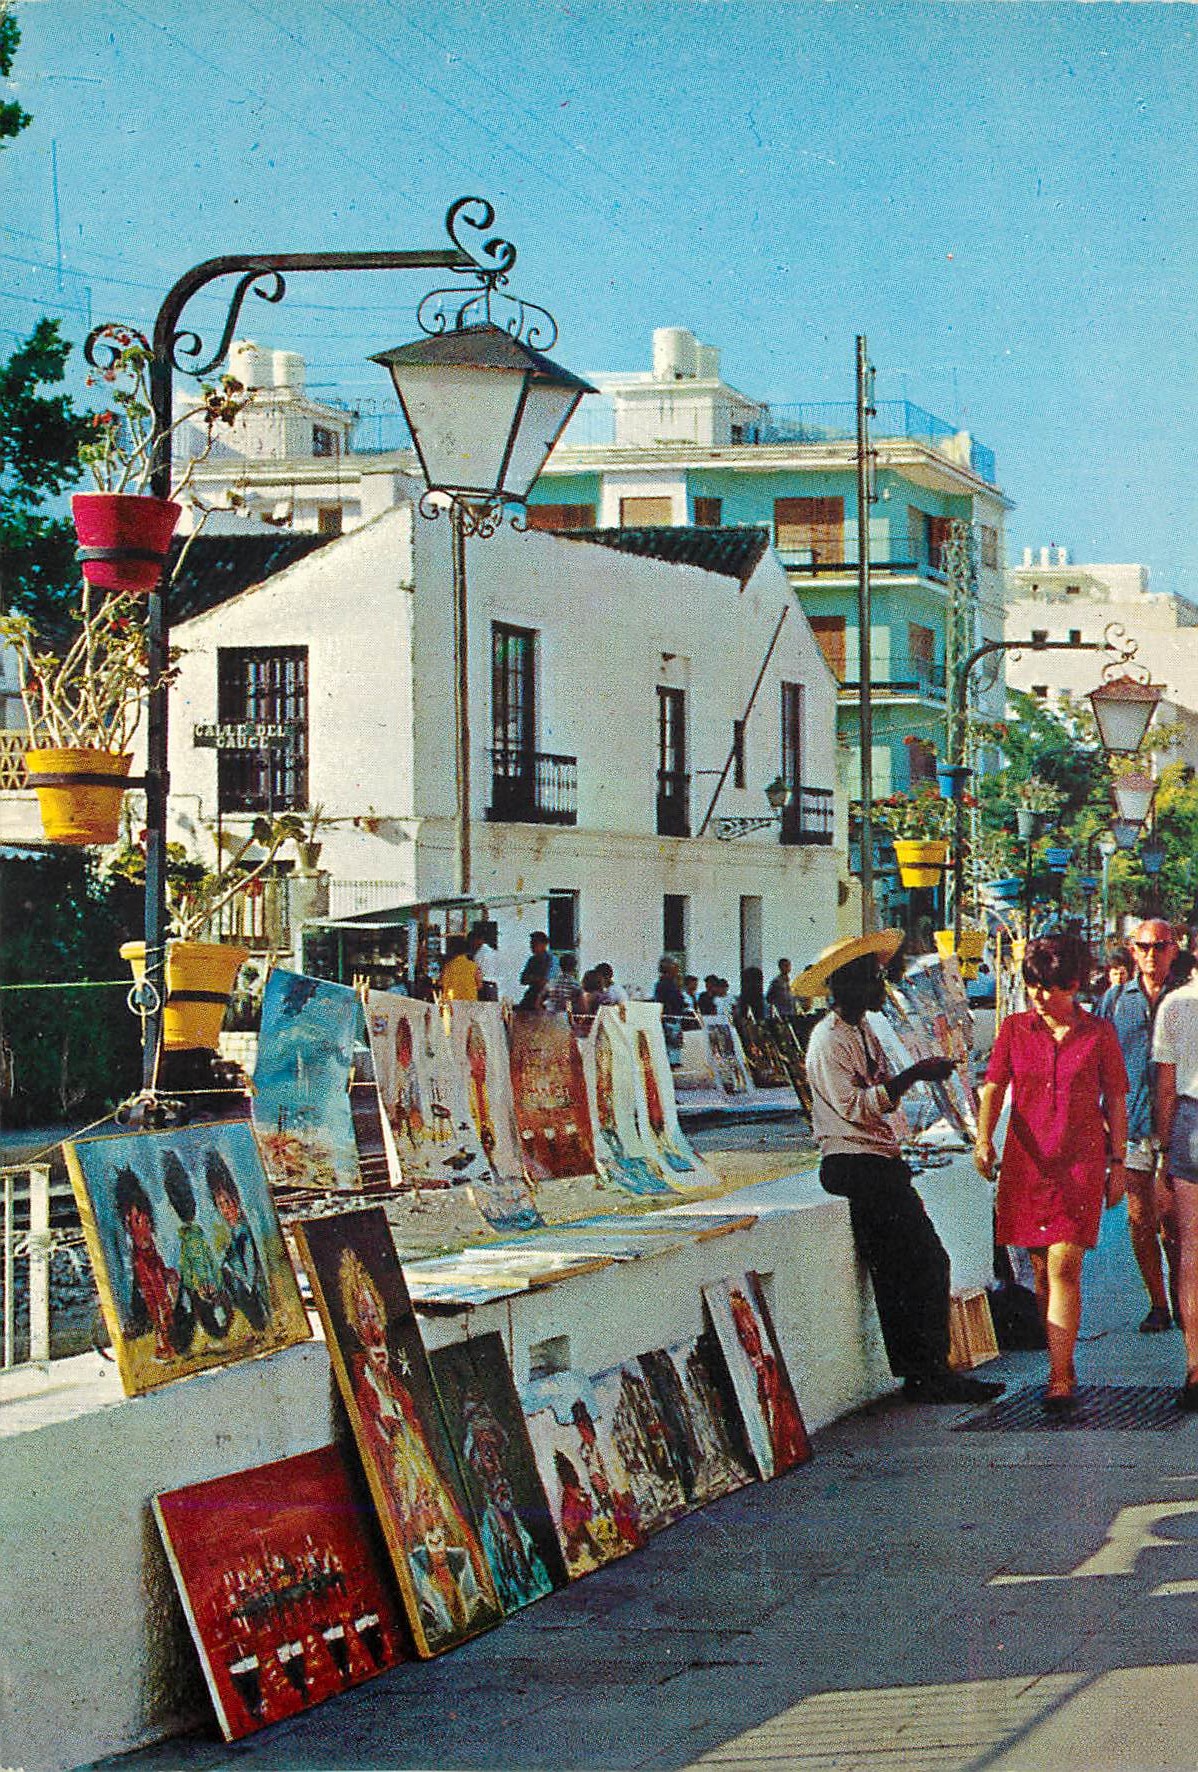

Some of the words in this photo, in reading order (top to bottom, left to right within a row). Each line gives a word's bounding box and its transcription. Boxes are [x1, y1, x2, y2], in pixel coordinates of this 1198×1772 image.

[195, 724, 247, 737] CALLE
[256, 724, 286, 737] DEL
[216, 736, 269, 749] CAUCE
